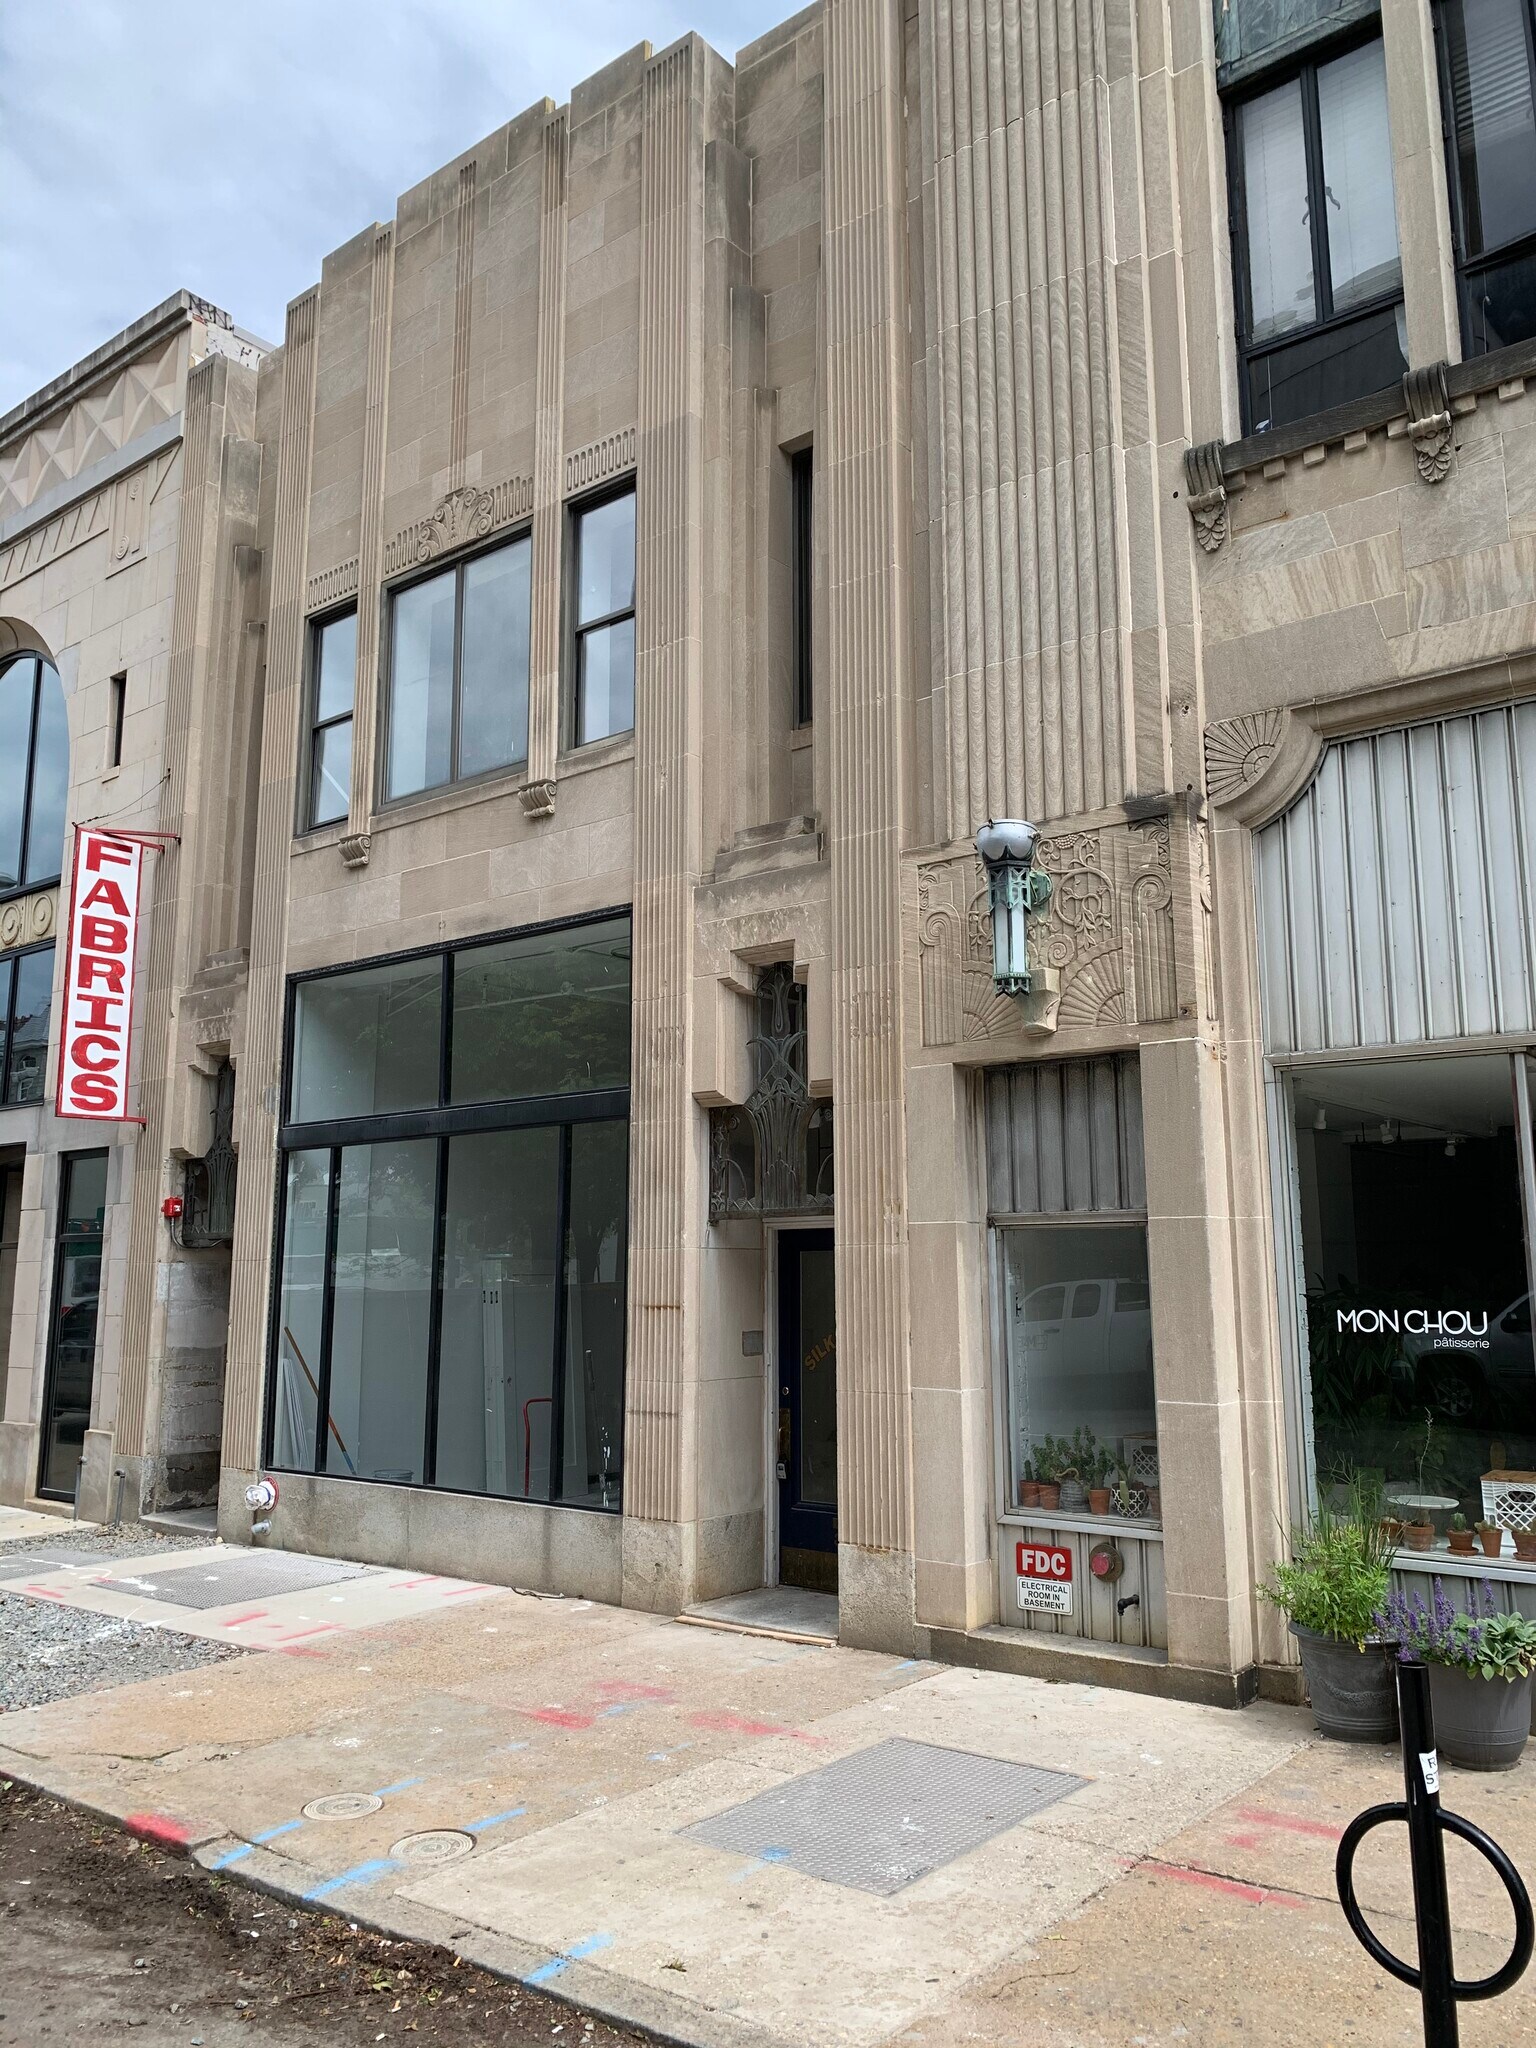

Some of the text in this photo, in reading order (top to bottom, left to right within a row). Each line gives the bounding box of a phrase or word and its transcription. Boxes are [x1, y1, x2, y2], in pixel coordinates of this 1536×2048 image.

[69, 837, 133, 1111] FABRICS
[1336, 1309, 1488, 1336] MON CHOU
[1433, 1336, 1490, 1349] pâtisserie
[804, 1334, 836, 1372] SILK
[1021, 1548, 1066, 1576] FDC
[1021, 1581, 1068, 1594] ELECTRICAL
[1027, 1590, 1060, 1601] ROOM IN
[1024, 1598, 1066, 1611] BASEMENT
